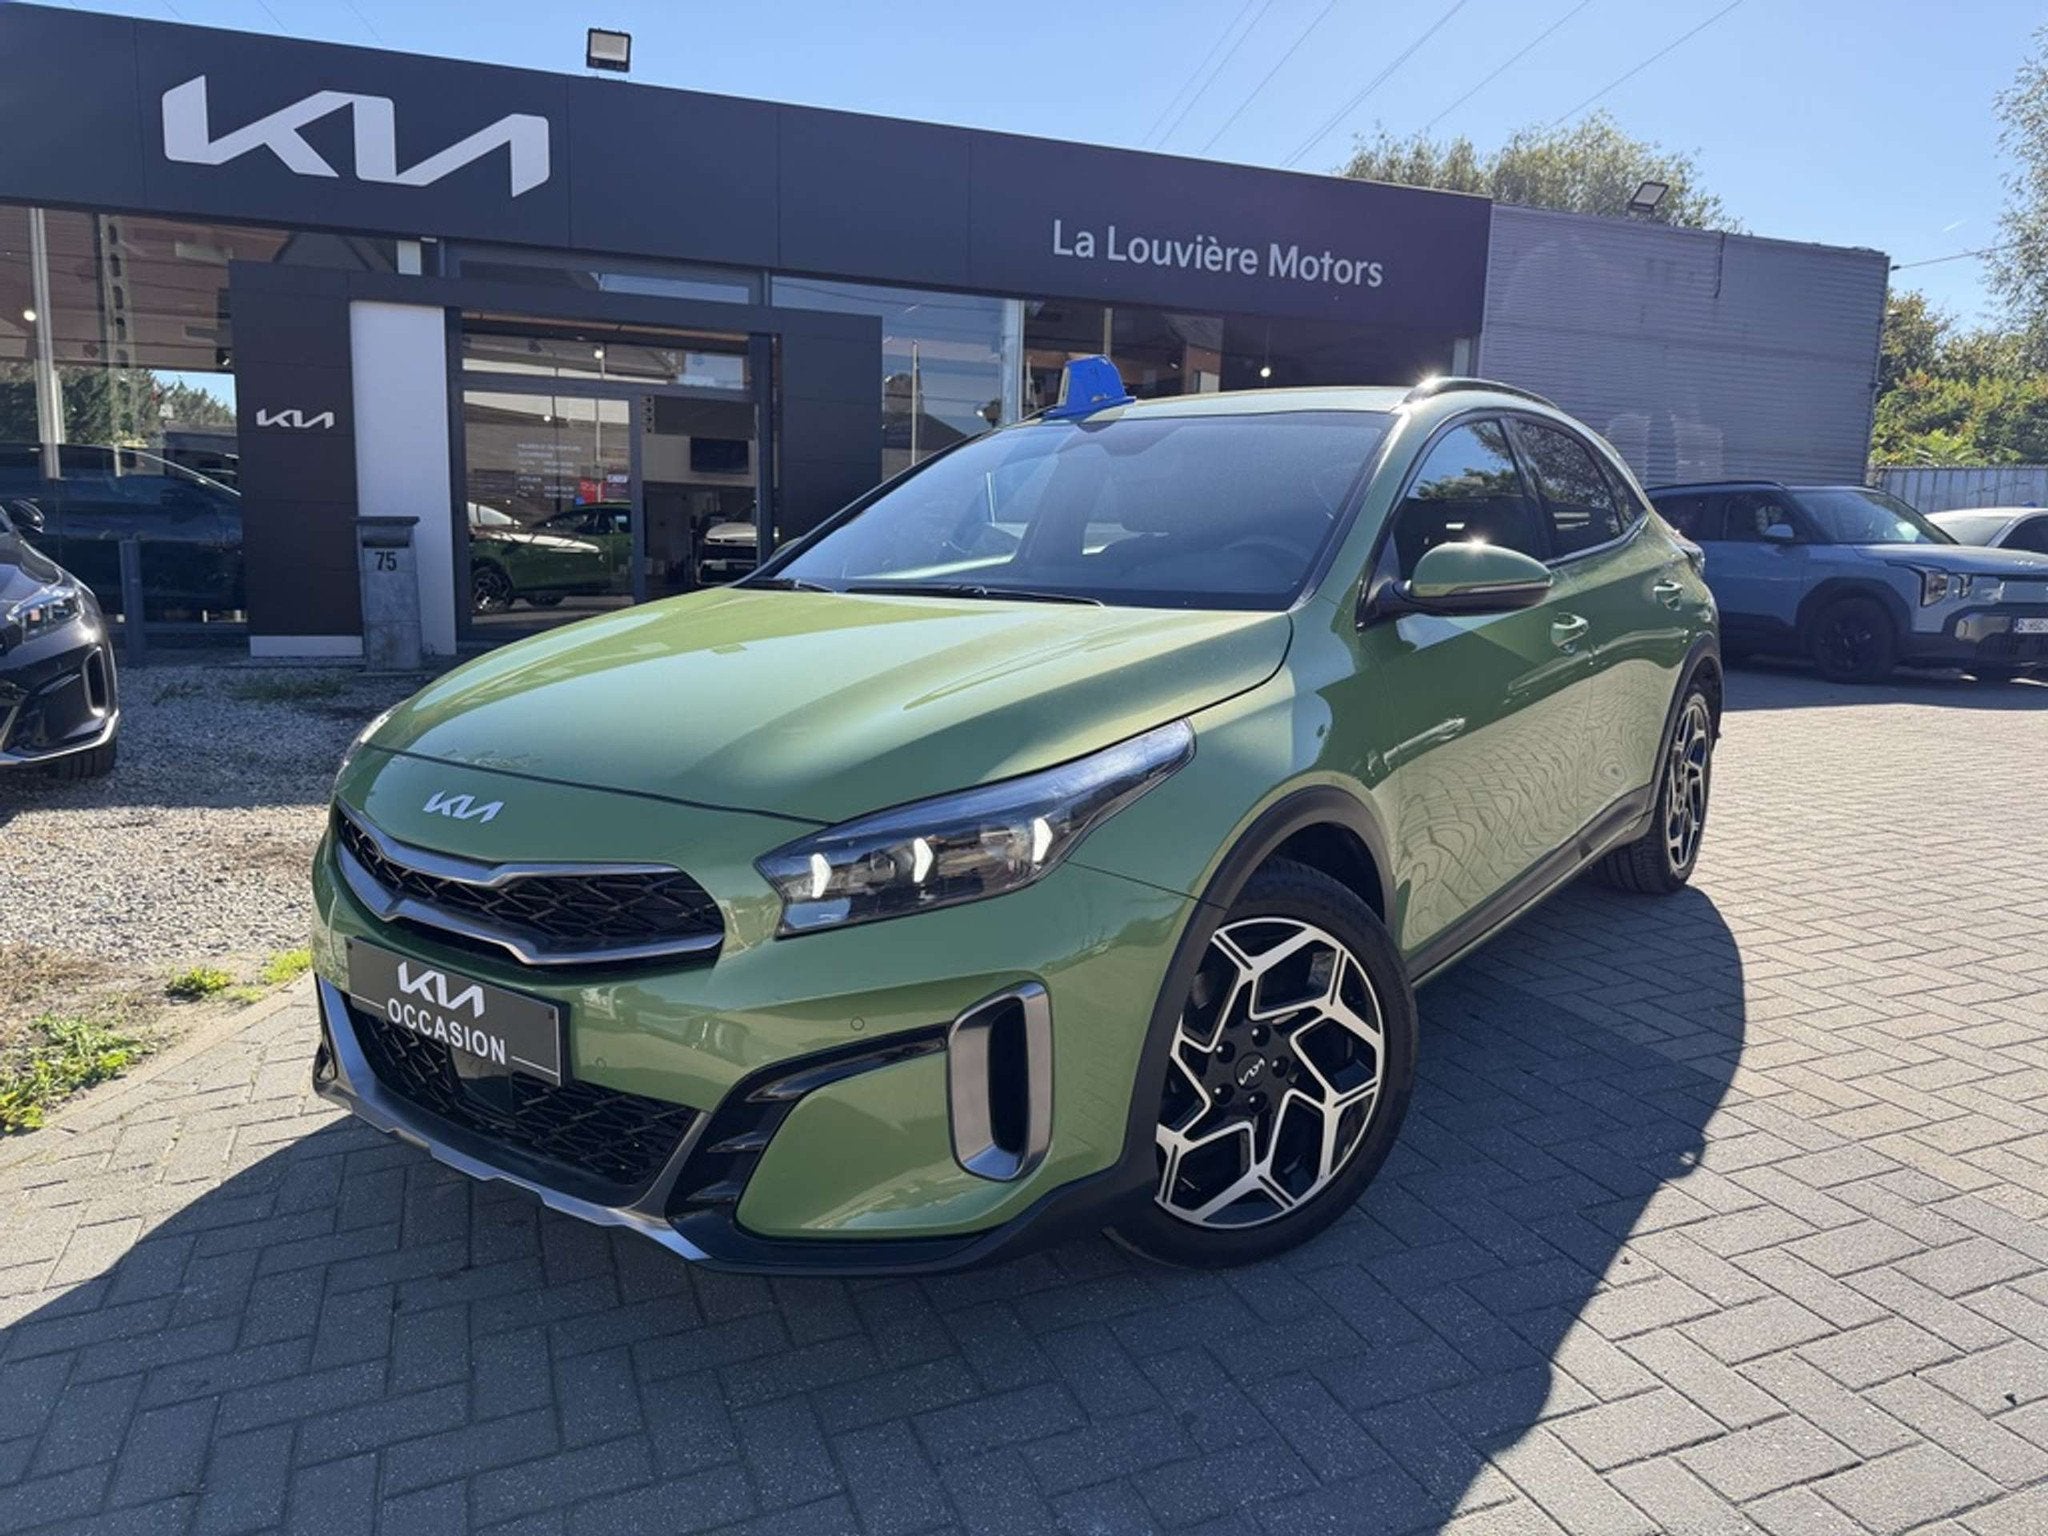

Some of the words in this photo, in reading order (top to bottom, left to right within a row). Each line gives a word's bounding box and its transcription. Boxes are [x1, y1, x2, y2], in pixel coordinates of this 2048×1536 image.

[162, 75, 550, 197] KIA
[1054, 219, 1095, 259] La
[1108, 225, 1259, 276] Louvière
[1269, 243, 1383, 288] Motors
[256, 408, 335, 429] KIA
[374, 551, 398, 572] 75
[422, 790, 505, 824] KIA
[397, 961, 486, 1019] KIA
[387, 997, 507, 1066] OCCASION
